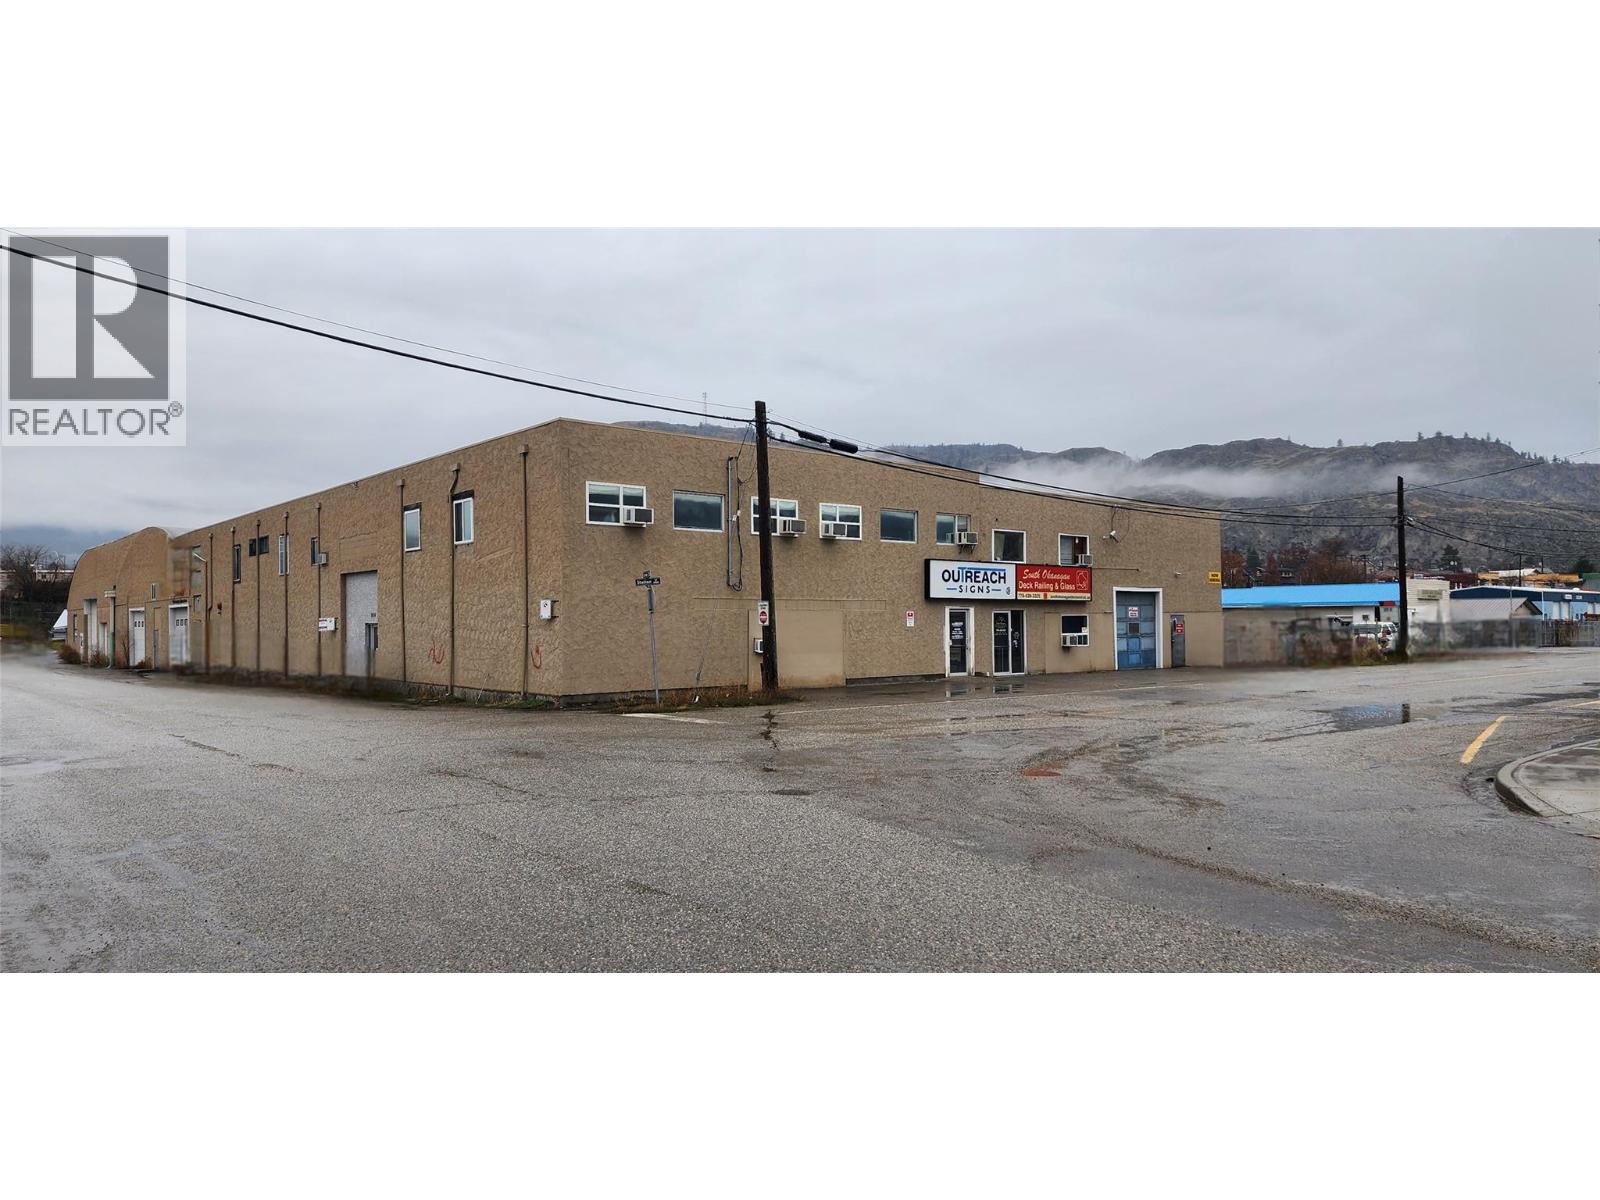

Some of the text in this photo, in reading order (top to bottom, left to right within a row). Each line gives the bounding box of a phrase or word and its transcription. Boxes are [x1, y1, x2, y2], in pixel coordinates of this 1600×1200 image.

[941, 567, 1006, 584] OUTREACH
[1022, 569, 1071, 583] South Okanagan
[958, 584, 991, 593] SIGNS
[1018, 580, 1076, 591] Deck Railing & Glass
